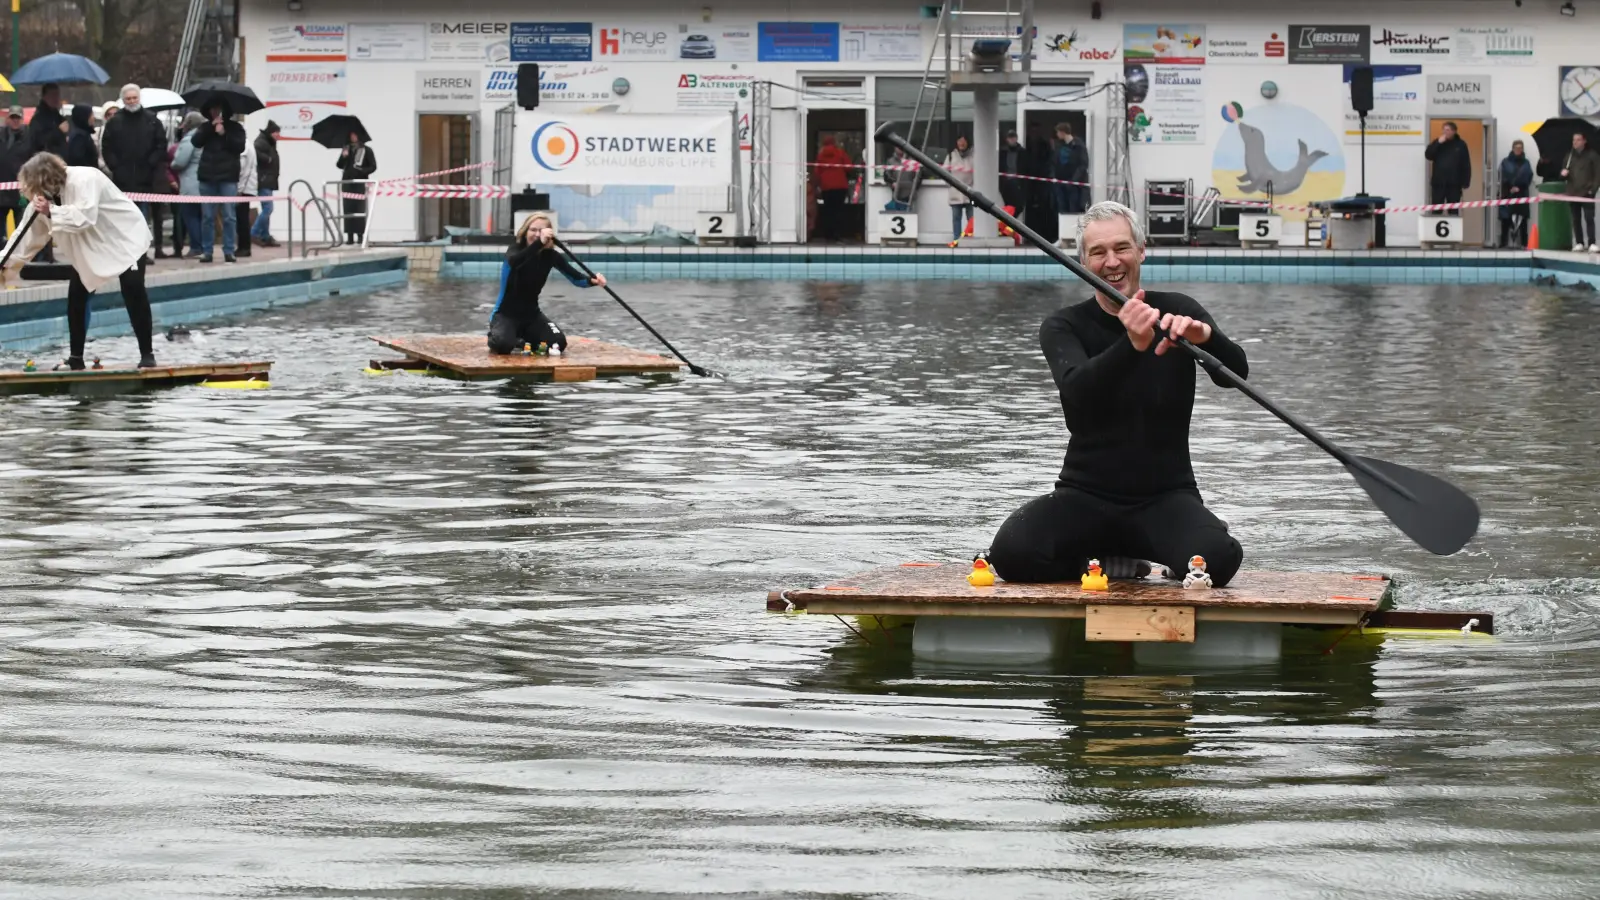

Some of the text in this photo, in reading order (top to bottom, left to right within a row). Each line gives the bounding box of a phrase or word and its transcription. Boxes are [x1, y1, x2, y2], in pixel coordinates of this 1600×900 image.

[443, 22, 508, 34] MEIER
[511, 36, 547, 44] FRICKE
[622, 28, 668, 48] heye
[1207, 39, 1248, 47] Sparkasse
[1298, 27, 1360, 49] KIERSTEIN
[1079, 47, 1110, 60] rabe
[424, 78, 472, 89] HERREN
[1437, 82, 1480, 94] DAMEN
[584, 136, 717, 153] STADTWERKE
[584, 155, 718, 169] SCHAUMBURG-LIPPE
[708, 216, 723, 234] 2
[891, 216, 907, 235] 3
[1255, 220, 1270, 237] 5
[1435, 220, 1450, 237] 6
